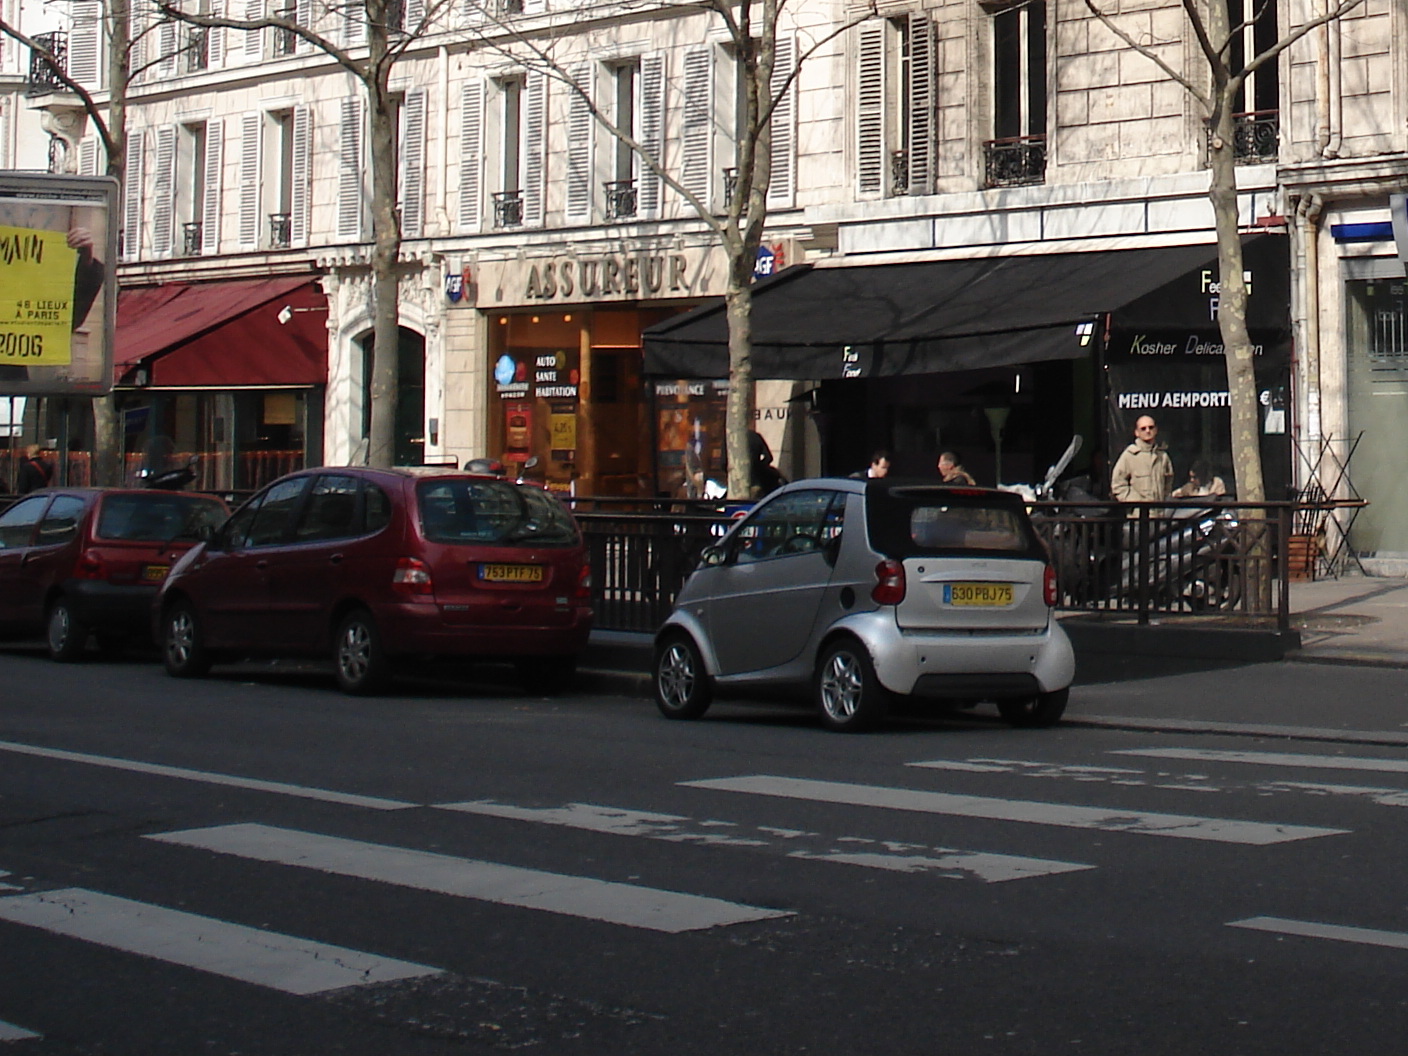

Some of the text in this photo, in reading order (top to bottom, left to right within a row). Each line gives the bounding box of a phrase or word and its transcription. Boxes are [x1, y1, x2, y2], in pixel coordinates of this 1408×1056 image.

[527, 254, 689, 299] ASSUREUR
[36, 300, 68, 310] LIEUX
[27, 310, 60, 320] PARIS
[1130, 335, 1263, 355] Kosher Delicaen
[536, 356, 556, 367] AUTO
[535, 386, 577, 397] HABITATION
[1118, 393, 1160, 409] MENU
[486, 566, 540, 578] 753 PTF 75
[952, 587, 1012, 601] 630 PBJ 75
